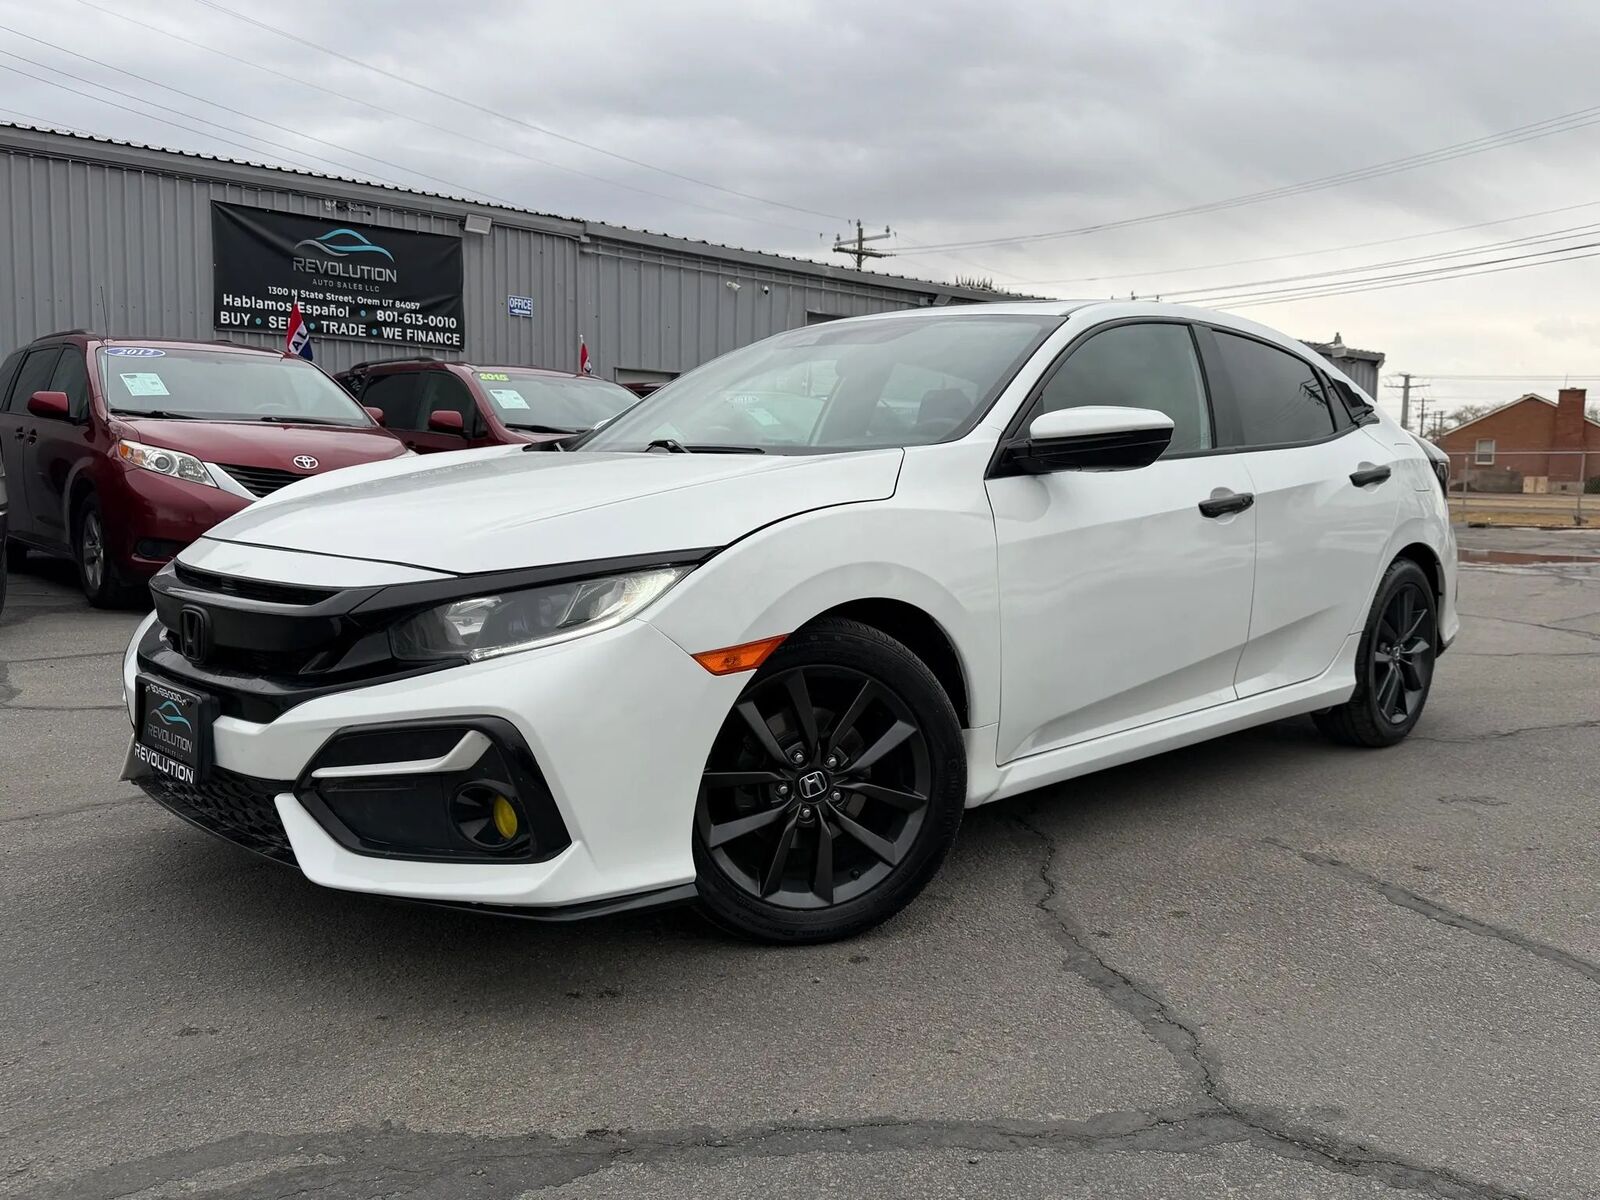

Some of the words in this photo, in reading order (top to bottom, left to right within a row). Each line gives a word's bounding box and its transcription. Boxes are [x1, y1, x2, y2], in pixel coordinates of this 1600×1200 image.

[293, 257, 397, 283] REVOLUTION
[268, 286, 289, 296] 1300
[291, 289, 298, 297] N
[300, 290, 324, 300] State
[326, 293, 355, 304] Street,
[357, 296, 380, 306] Orem
[382, 299, 394, 307] UT
[395, 301, 420, 310] 84057
[312, 279, 334, 287] AUTO
[337, 281, 363, 291] SALES
[365, 285, 380, 293] LLC
[223, 294, 292, 312] Hablamos
[298, 301, 349, 318] Español
[376, 310, 457, 329] 801-613-0010
[509, 298, 532, 310] OFFICE
[220, 311, 251, 326] BUY
[321, 321, 367, 337] TRADE
[382, 327, 402, 340] WE
[406, 329, 460, 345] FINANCE
[147, 723, 193, 753] REVOLUTION
[134, 743, 194, 784] REVOLUTION
